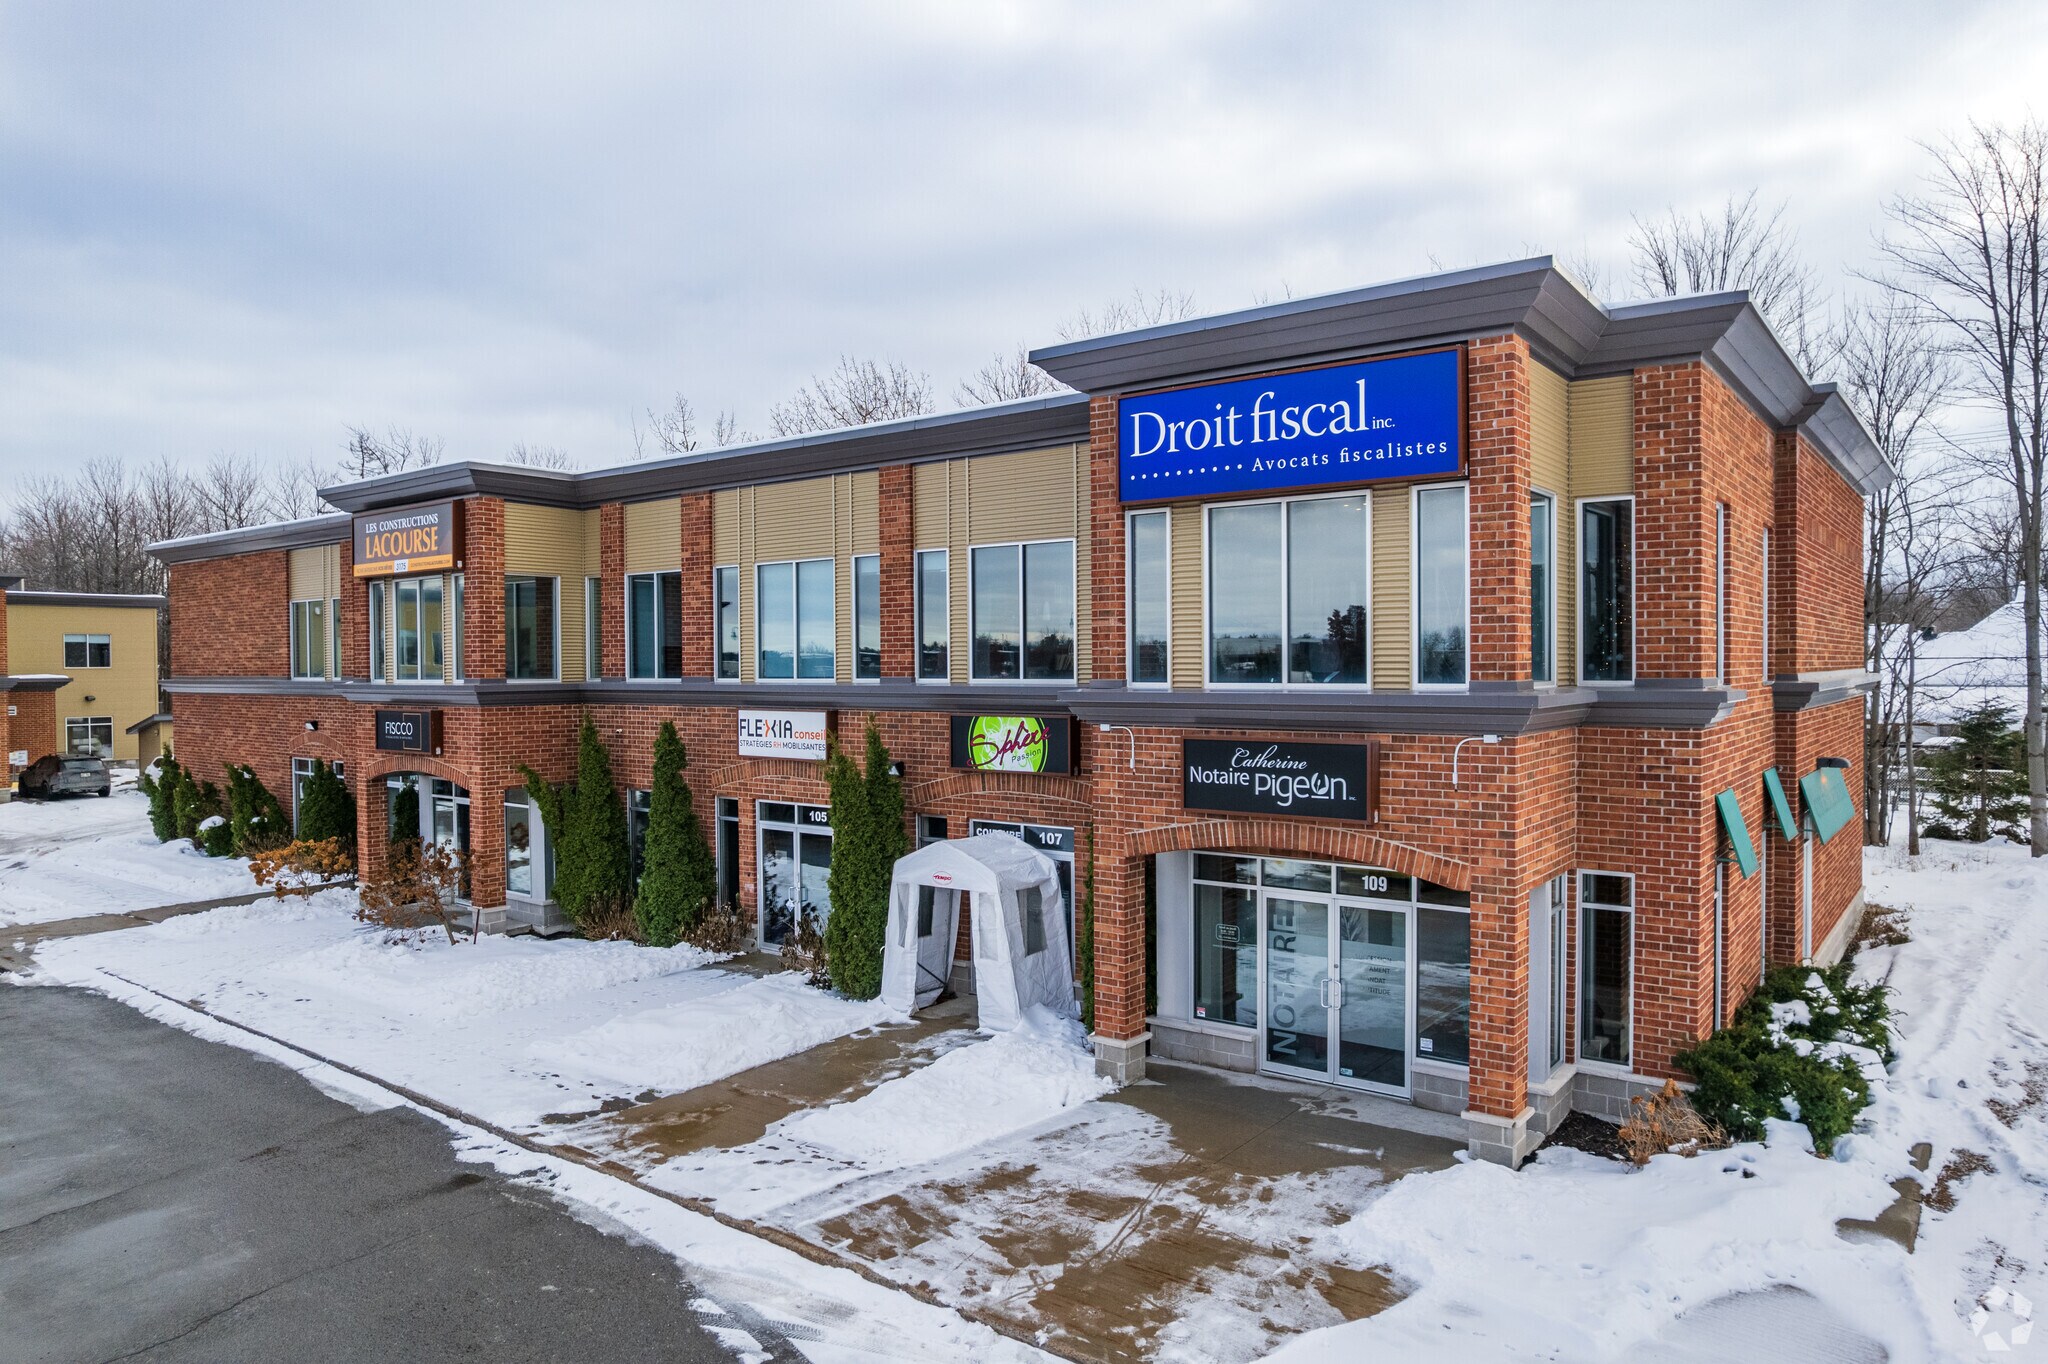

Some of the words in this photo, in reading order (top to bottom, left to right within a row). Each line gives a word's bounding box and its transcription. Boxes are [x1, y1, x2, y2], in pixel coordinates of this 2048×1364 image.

[1130, 403, 1243, 458] Droit
[1250, 378, 1369, 444] fiscal
[1371, 415, 1396, 430] inc.
[1251, 452, 1329, 472] Avocats
[1339, 440, 1448, 463] fiscalistes
[365, 522, 377, 534] LES
[379, 513, 439, 532] CONSTRUCTIONS
[365, 526, 439, 559] LACOURSE
[385, 721, 413, 736] FISCCO
[740, 718, 793, 739] FLEXIA
[794, 729, 826, 741] conseil
[740, 738, 772, 749] STRATÉGIES
[773, 741, 782, 749] RH
[783, 742, 826, 752] MOBILISANTES
[1011, 748, 1042, 763] Passion
[1231, 744, 1308, 770] Catherine
[1190, 766, 1250, 786] Notaire
[809, 810, 827, 823] 105
[1039, 832, 1063, 846] 107
[1362, 875, 1387, 892] 109
[1273, 914, 1297, 1055] NOTAIRE
